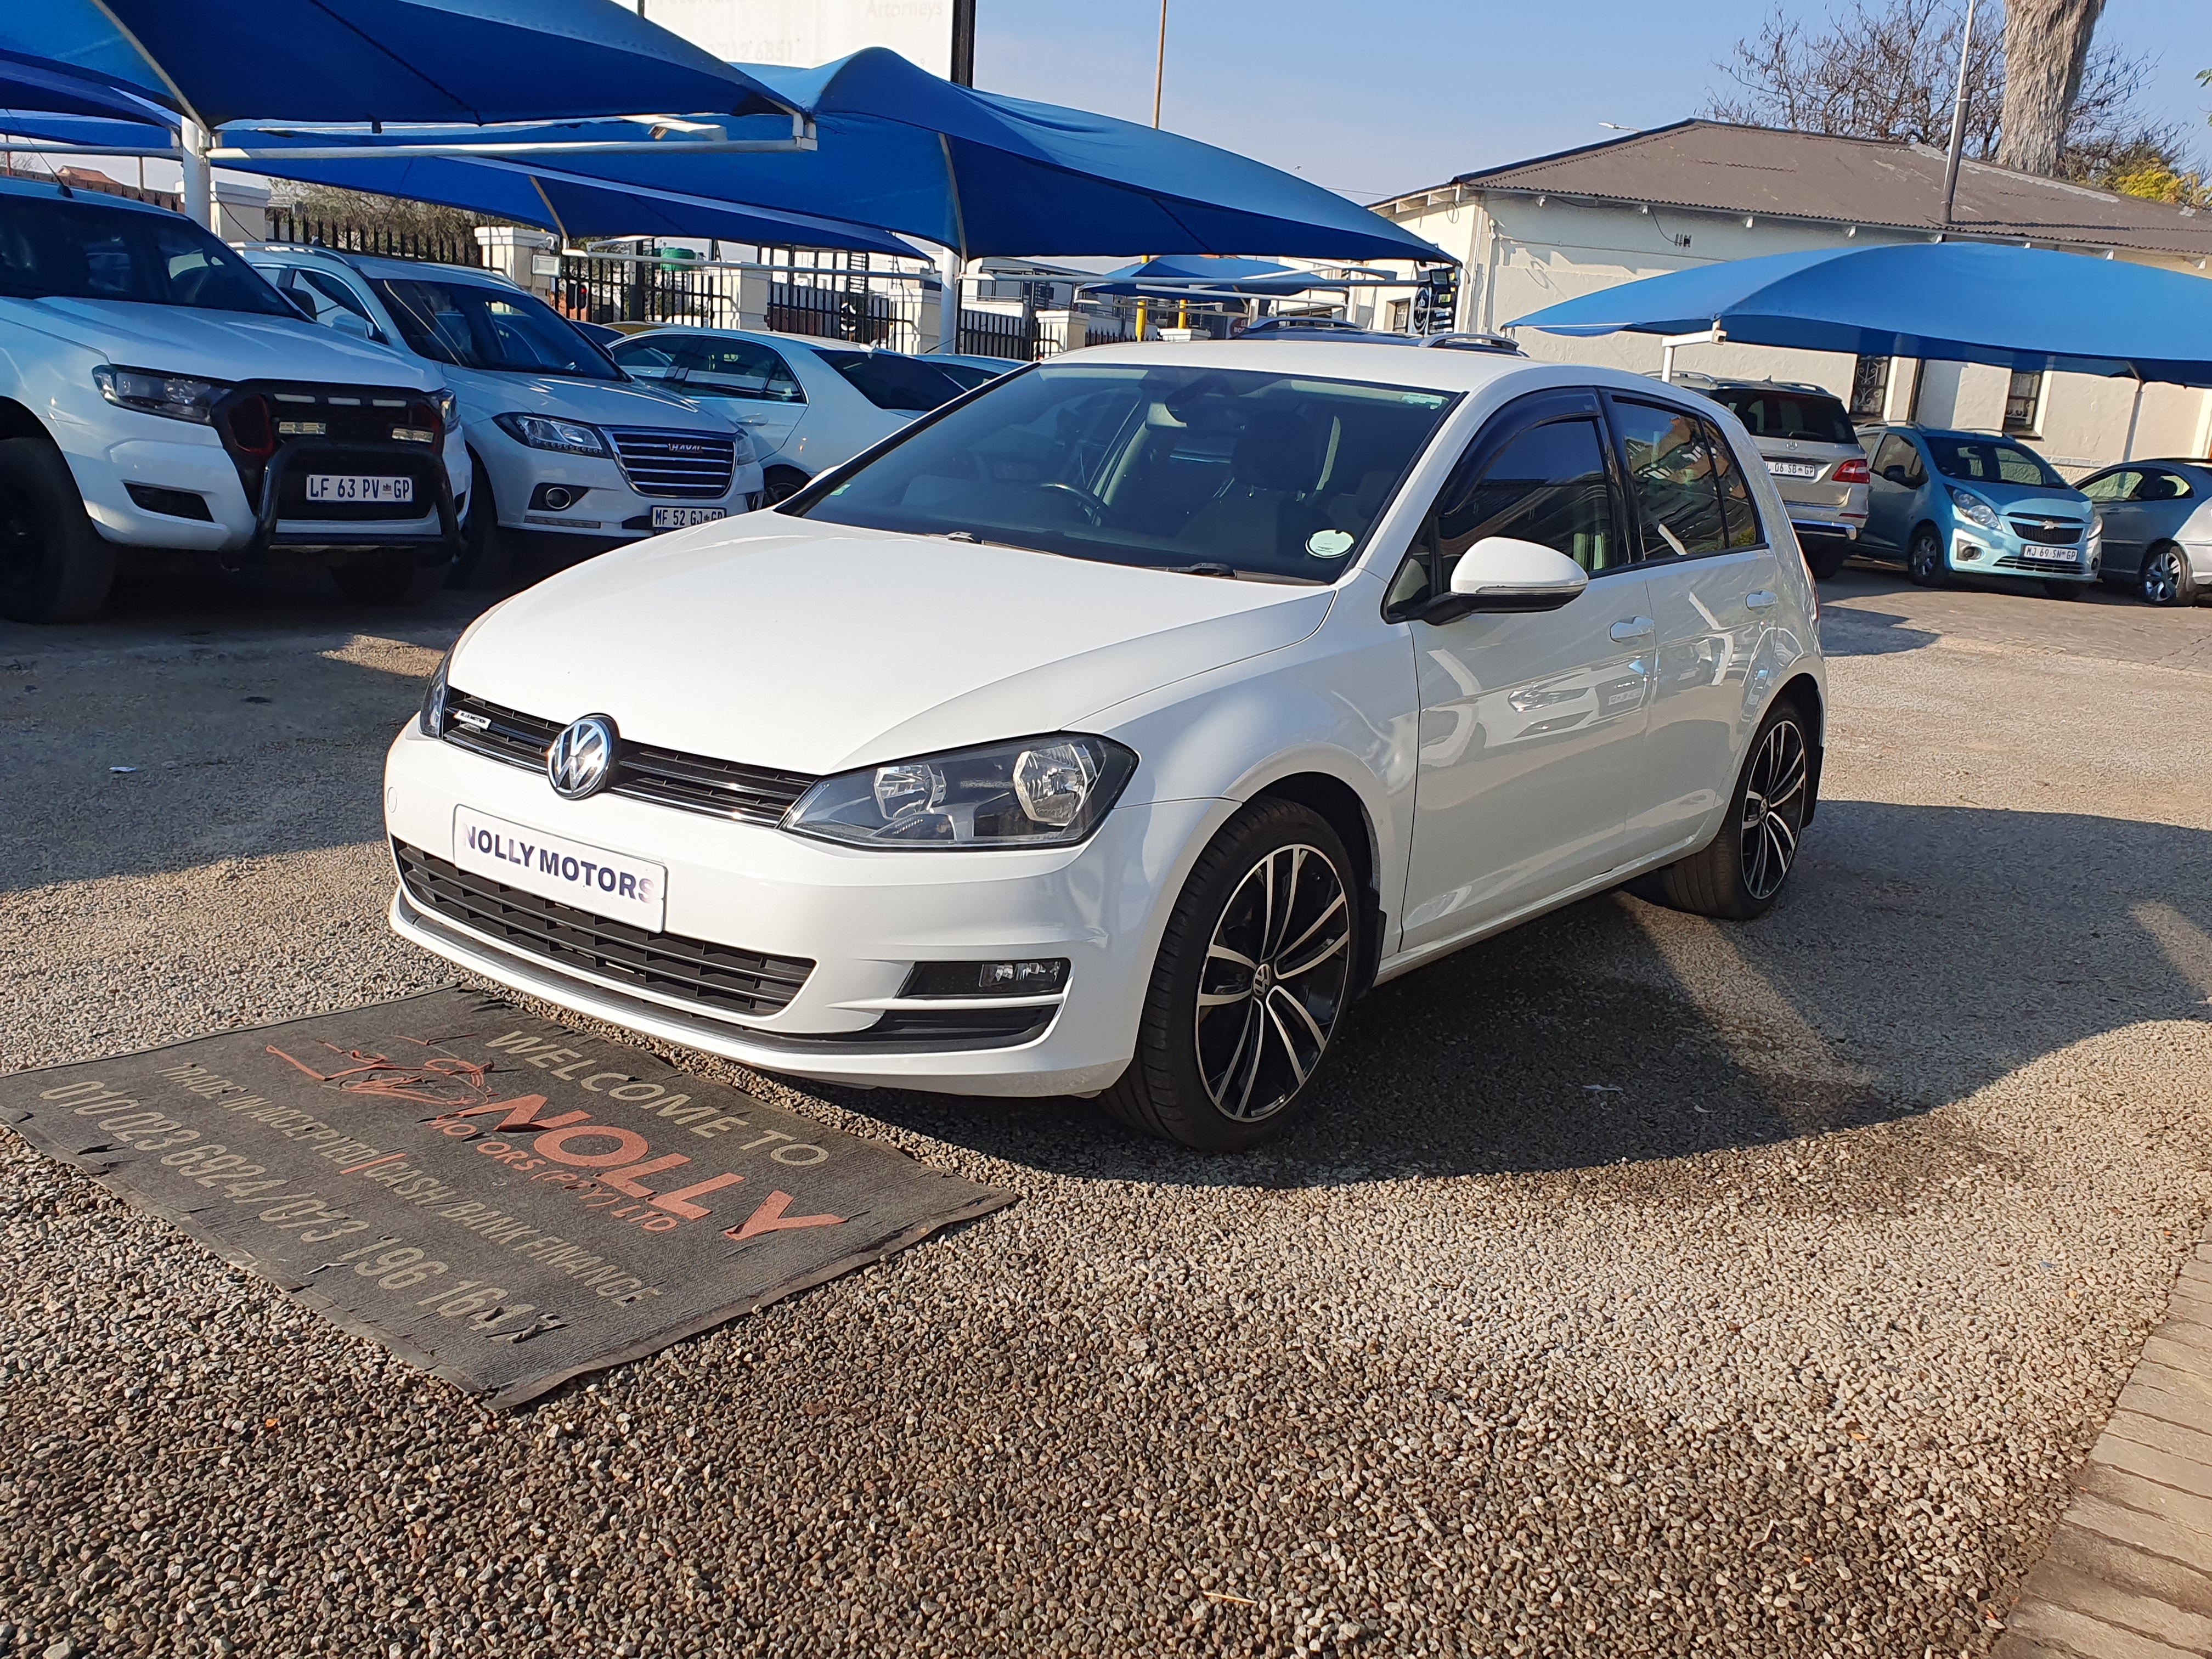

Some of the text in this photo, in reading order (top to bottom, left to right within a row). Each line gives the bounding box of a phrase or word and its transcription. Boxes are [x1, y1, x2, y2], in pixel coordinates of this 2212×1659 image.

[865, 0, 943, 22] Attorneys
[1775, 462, 1784, 472] 06
[1787, 462, 1797, 473] SB
[1804, 466, 1814, 475] GP
[310, 478, 410, 499] LF 63 PV GP
[655, 509, 668, 525] MF
[673, 510, 686, 526] 52
[690, 510, 703, 525] GJ
[2027, 546, 2076, 560] MJ 69 SN GP
[463, 823, 655, 905] NOLLY MOTORS
[154, 1062, 249, 1099] TRADE
[217, 1094, 274, 1112] IN
[485, 1030, 830, 1166] WELCOME TO
[241, 1105, 380, 1165] ACCEPTED
[437, 1093, 847, 1242] NOLLY
[39, 1080, 140, 1115] 010
[98, 1111, 201, 1151] 023
[337, 1236, 449, 1290] 196
[611, 1204, 679, 1232] LTD
[512, 1234, 663, 1308] FINANCE
